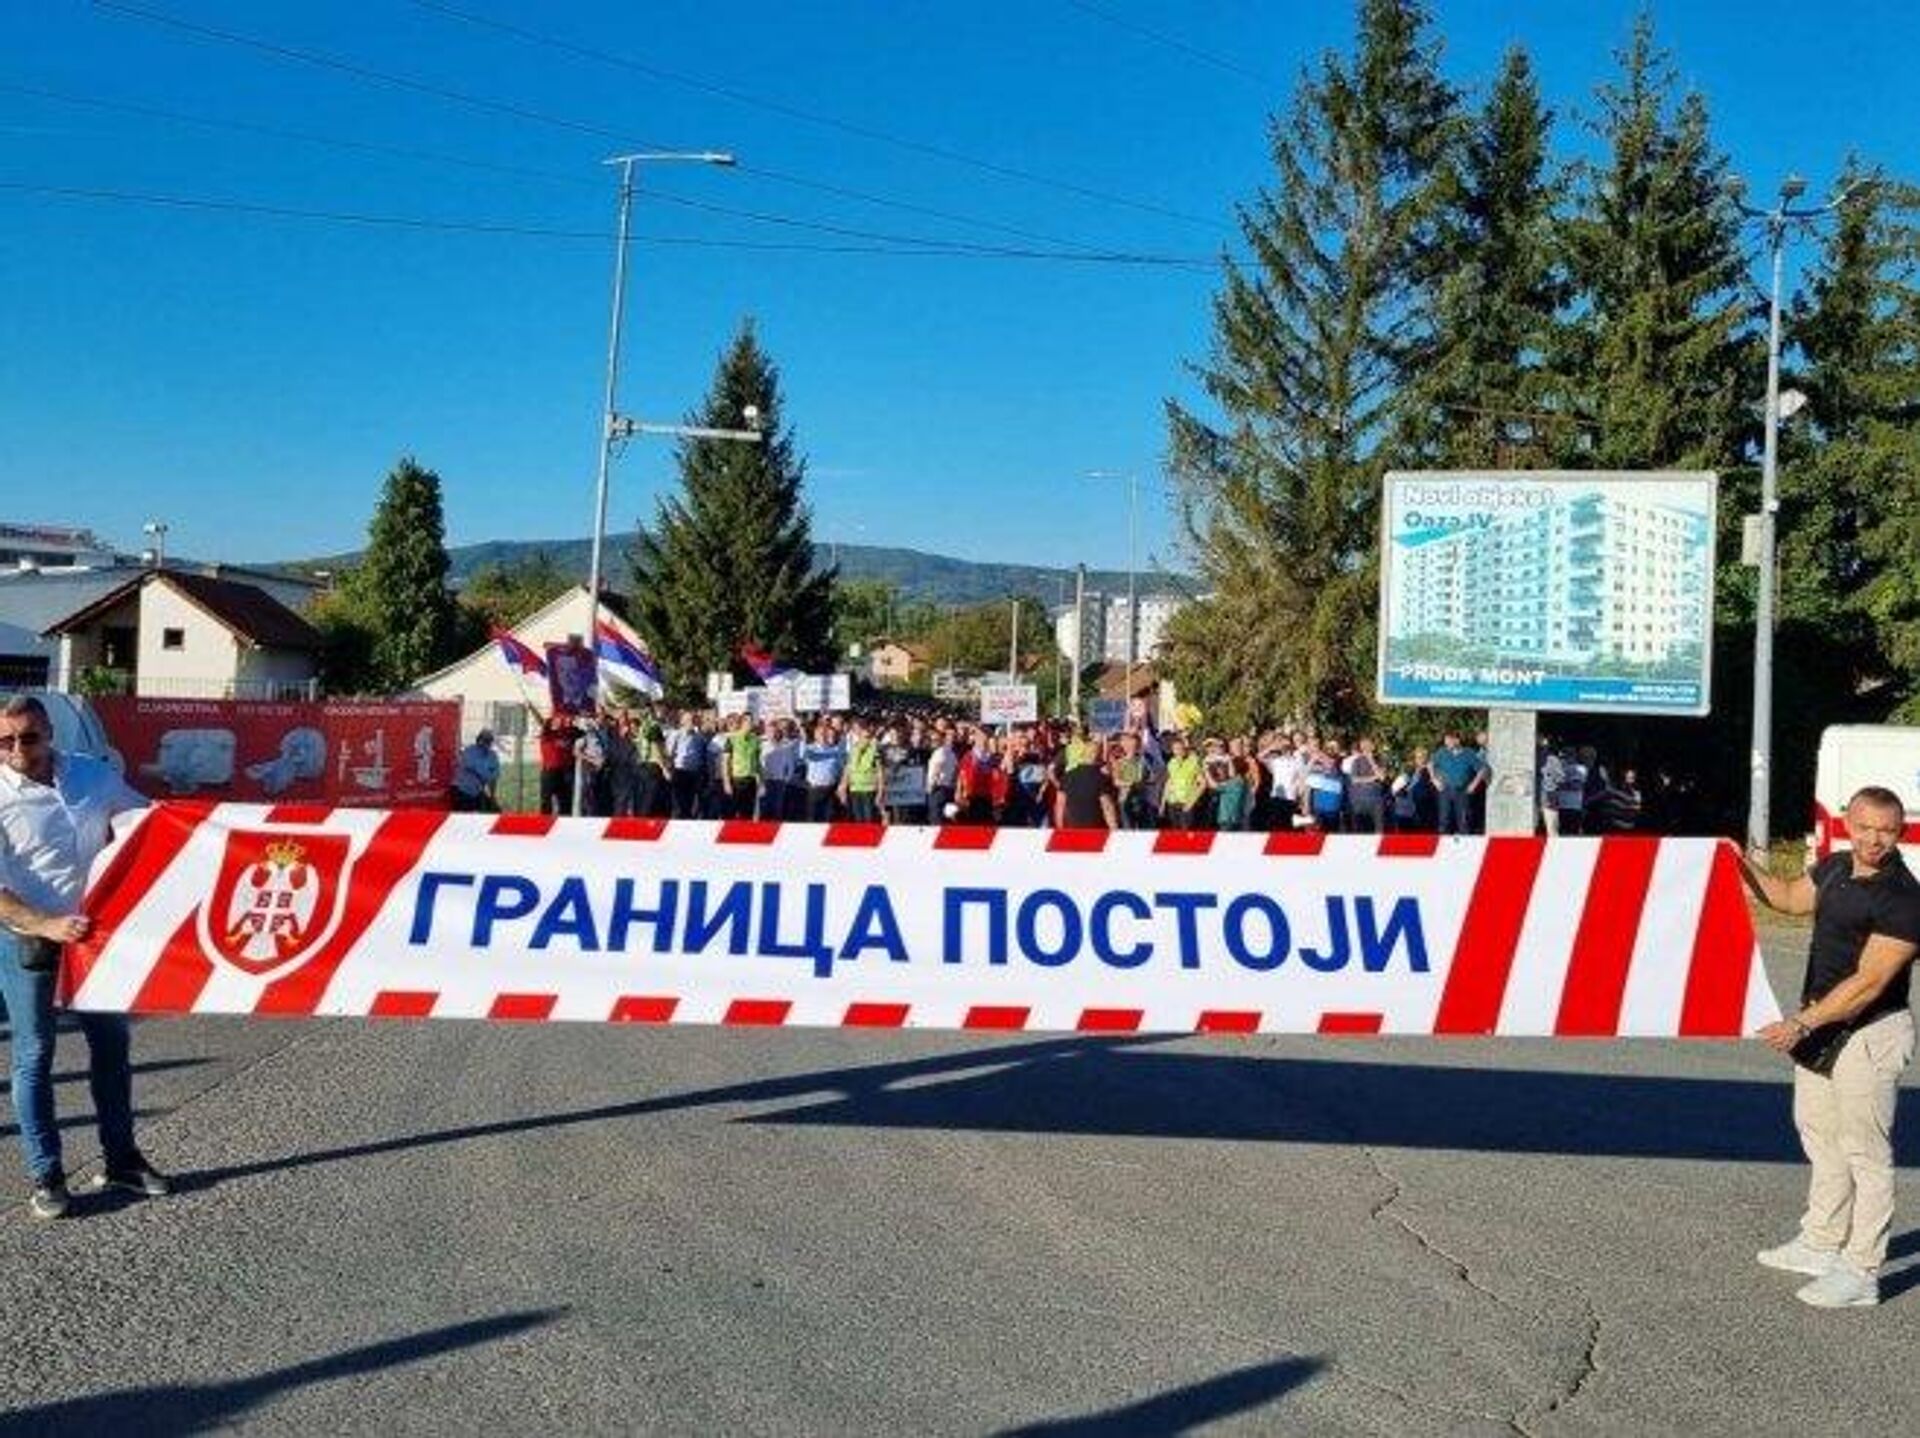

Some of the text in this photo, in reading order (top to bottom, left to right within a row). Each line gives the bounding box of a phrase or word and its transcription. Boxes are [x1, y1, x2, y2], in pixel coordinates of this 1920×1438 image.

[1403, 511, 1461, 528] Oaza
[1479, 669, 1545, 686] MONT
[408, 872, 1430, 977] ГРАНИЦА ПОСТОЈИ
